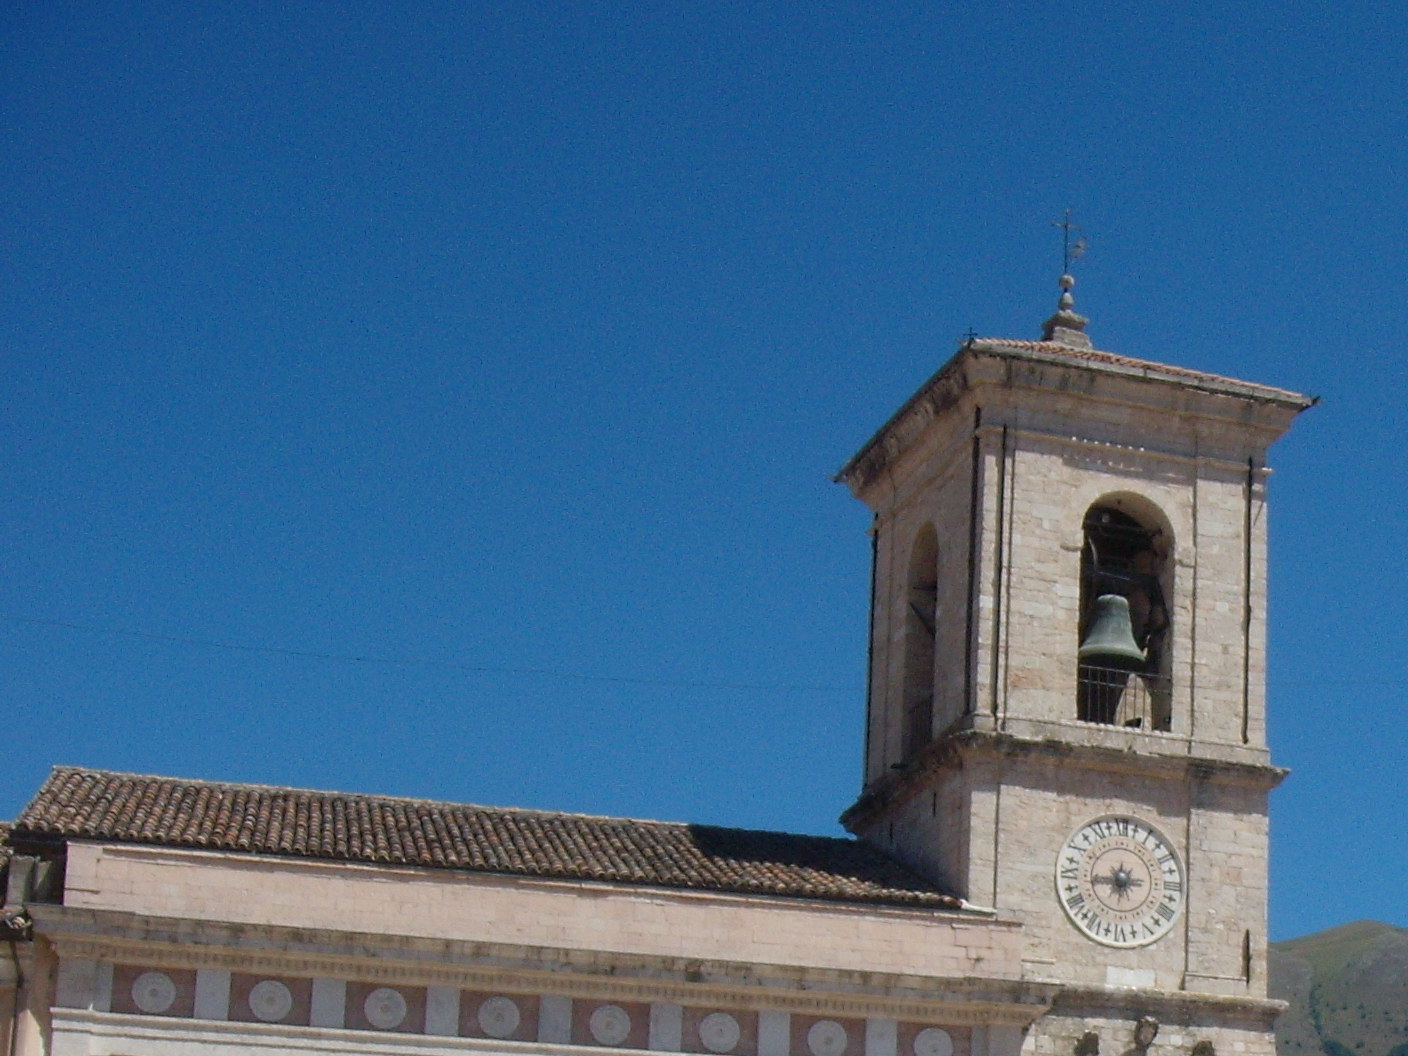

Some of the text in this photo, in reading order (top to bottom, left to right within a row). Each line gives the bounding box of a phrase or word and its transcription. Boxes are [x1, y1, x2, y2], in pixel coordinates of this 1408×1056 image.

[1088, 821, 1106, 839] XI
[1142, 828, 1154, 845] I
[1068, 839, 1087, 857] X
[1157, 852, 1175, 865] II
[1061, 863, 1080, 880] IX
[1163, 880, 1182, 892] III
[1113, 924, 1127, 943] VI
[1142, 923, 1154, 939] V
